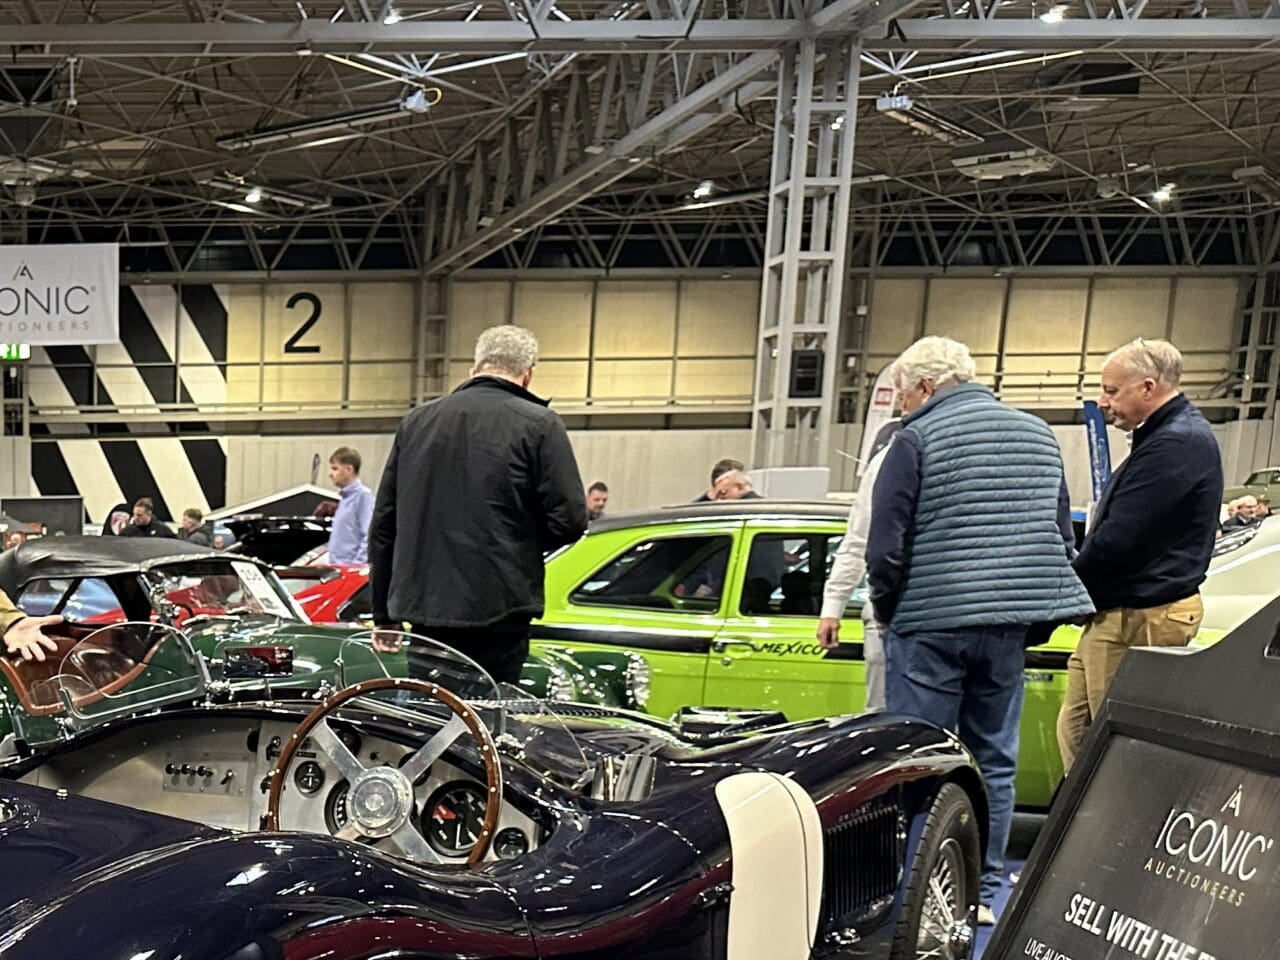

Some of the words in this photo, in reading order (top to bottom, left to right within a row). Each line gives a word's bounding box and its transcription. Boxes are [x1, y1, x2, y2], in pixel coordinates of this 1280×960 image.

[285, 292, 322, 353] 2
[762, 641, 824, 656] MEXICO
[1155, 808, 1266, 881] ICONIC
[1144, 857, 1245, 907] AUCTIONEERS
[1065, 893, 1106, 936] SELL
[1106, 910, 1159, 959] WITH
